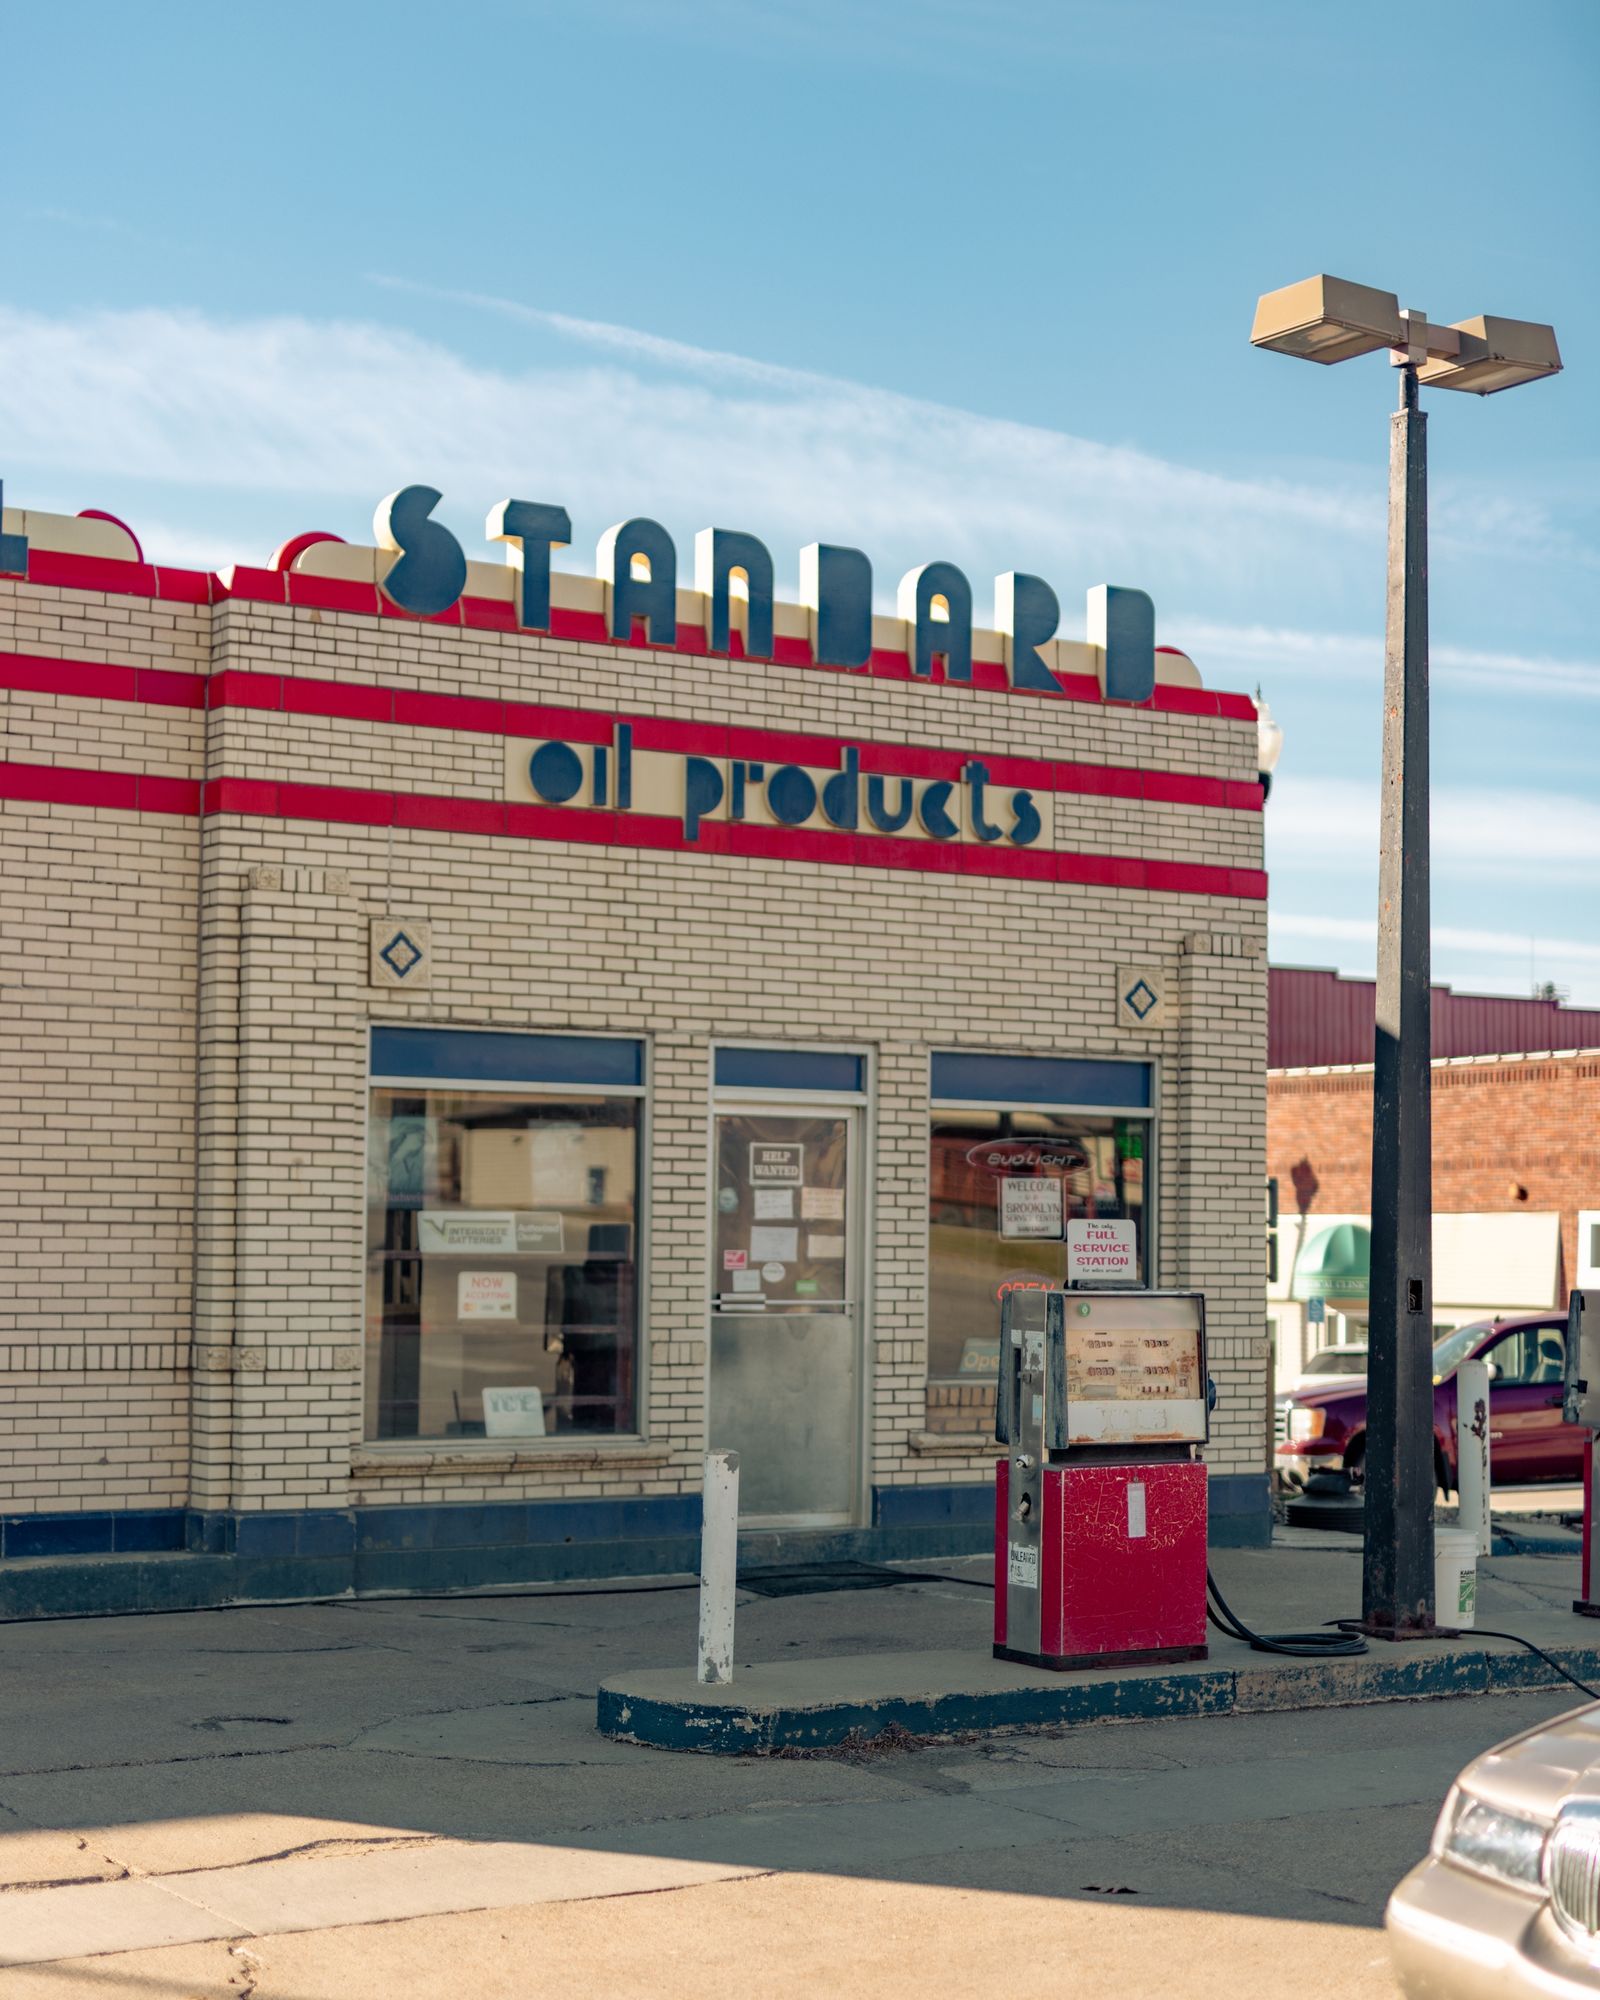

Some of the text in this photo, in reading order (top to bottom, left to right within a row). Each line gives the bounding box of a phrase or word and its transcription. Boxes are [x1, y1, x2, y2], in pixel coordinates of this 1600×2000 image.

[374, 484, 1155, 703] STANDARD
[529, 723, 1042, 846] oil products
[762, 1150, 791, 1162] HELP
[1025, 1153, 1077, 1166] LIGHT
[754, 1164, 799, 1176] WANTED
[1006, 1202, 1060, 1213] BROOKLYN
[449, 1227, 508, 1236] INTERSTATE
[1086, 1231, 1119, 1240] FULL
[448, 1236, 502, 1244] BATTERIES
[1073, 1243, 1131, 1253] SERVICE
[1076, 1256, 1129, 1266] STATION
[471, 1277, 503, 1288] NOW
